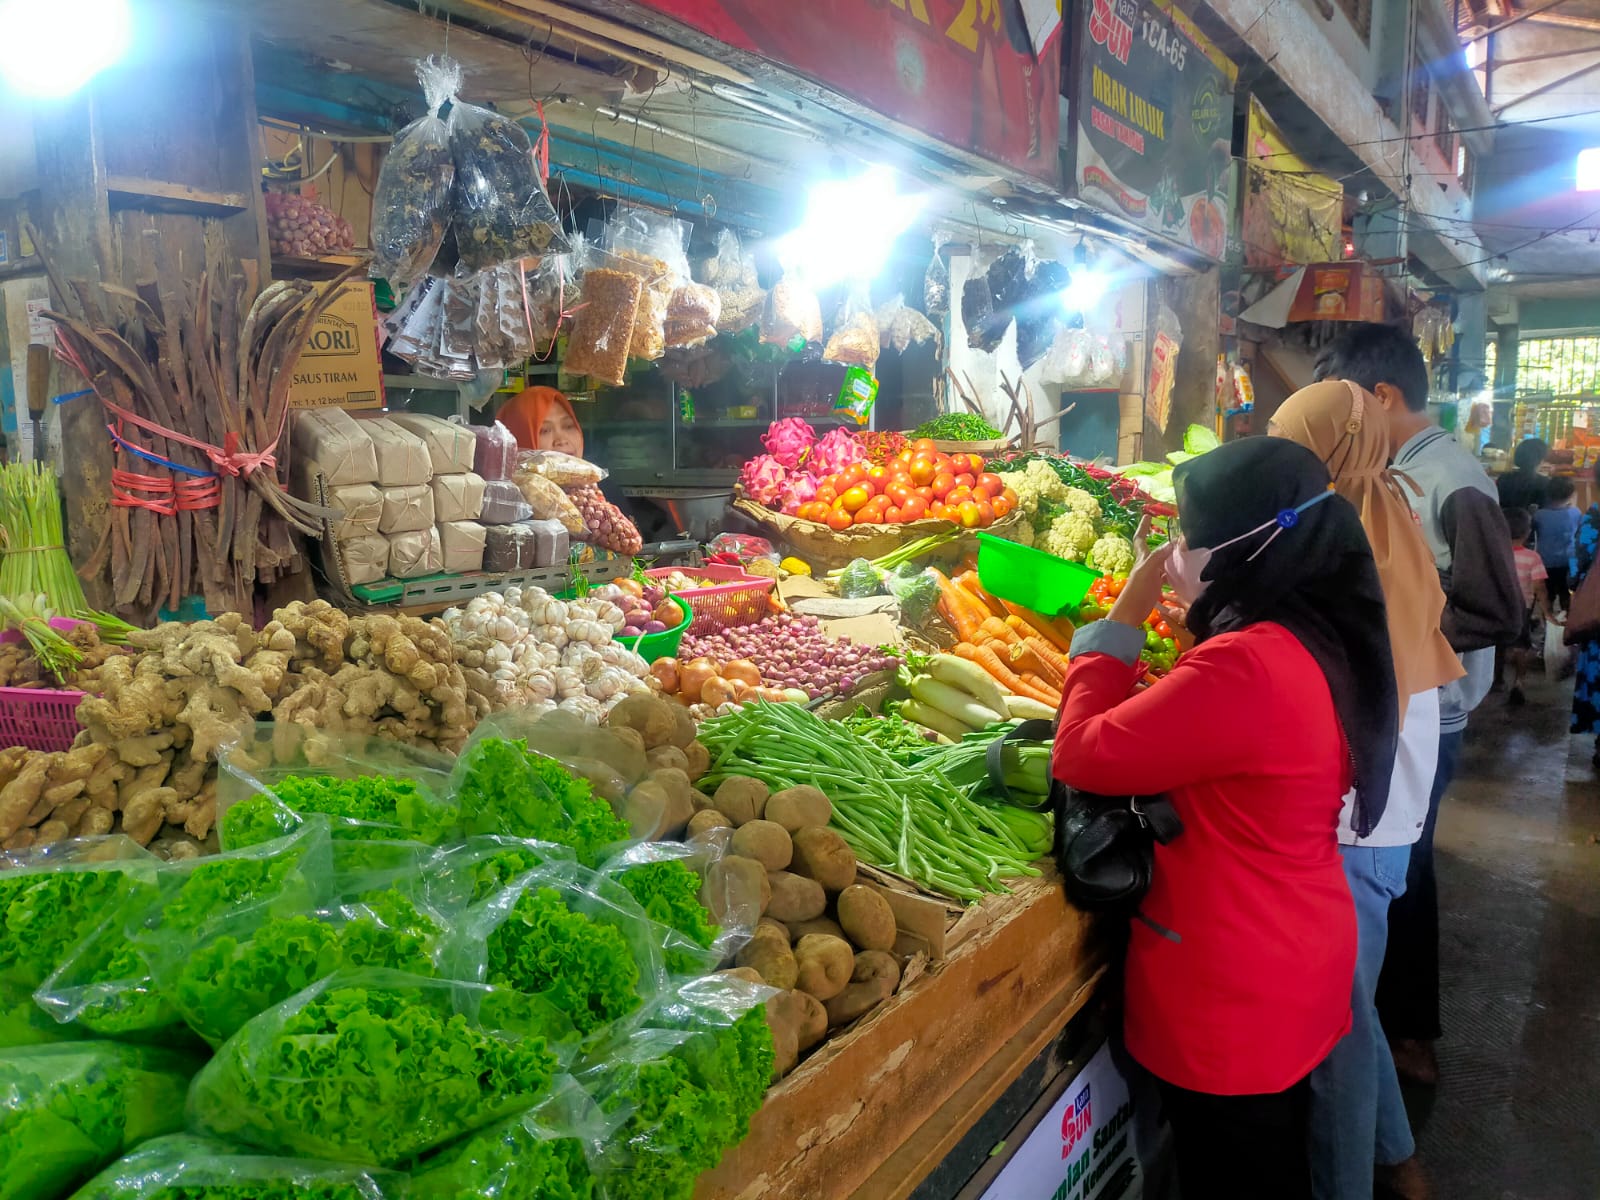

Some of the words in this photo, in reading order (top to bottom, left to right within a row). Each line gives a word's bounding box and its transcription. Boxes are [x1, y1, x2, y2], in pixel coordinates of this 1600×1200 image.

[1093, 64, 1127, 118] MBAK
[1129, 91, 1164, 140] LULUK
[293, 373, 322, 384] SAUS
[323, 372, 358, 383] TIRAM
